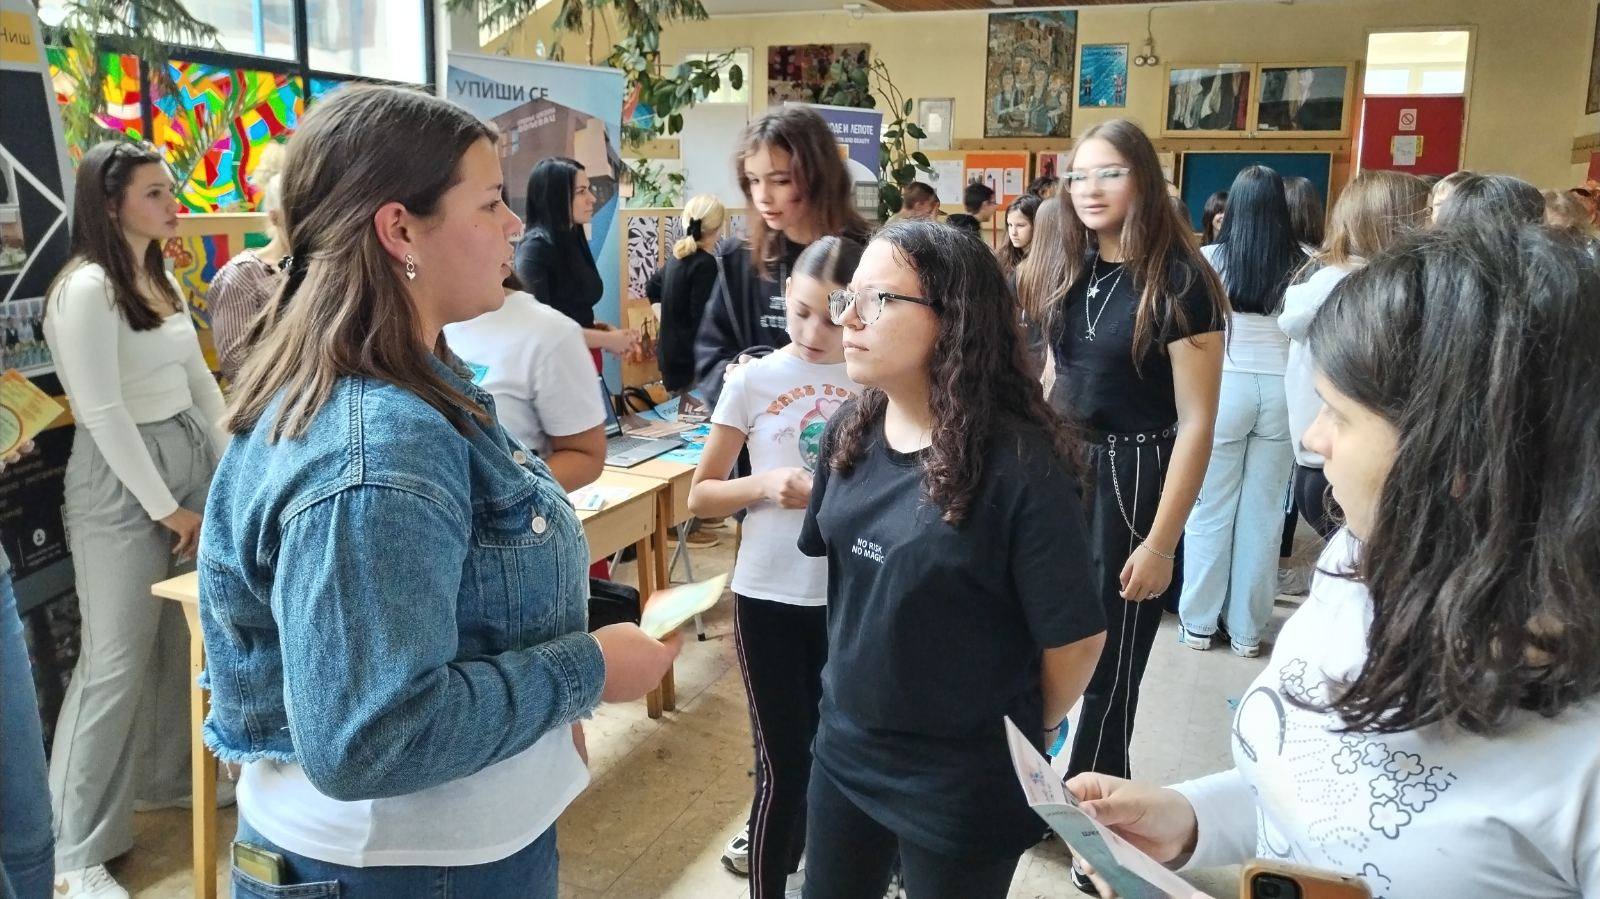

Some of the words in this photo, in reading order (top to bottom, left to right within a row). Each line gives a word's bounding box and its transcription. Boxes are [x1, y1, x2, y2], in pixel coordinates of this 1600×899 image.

[456, 80, 524, 101] УПИШИ
[529, 86, 549, 101] СЕ
[852, 545, 862, 555] NO
[864, 549, 884, 564] MAGIC
[858, 538, 867, 547] NO
[869, 542, 882, 553] RISK
